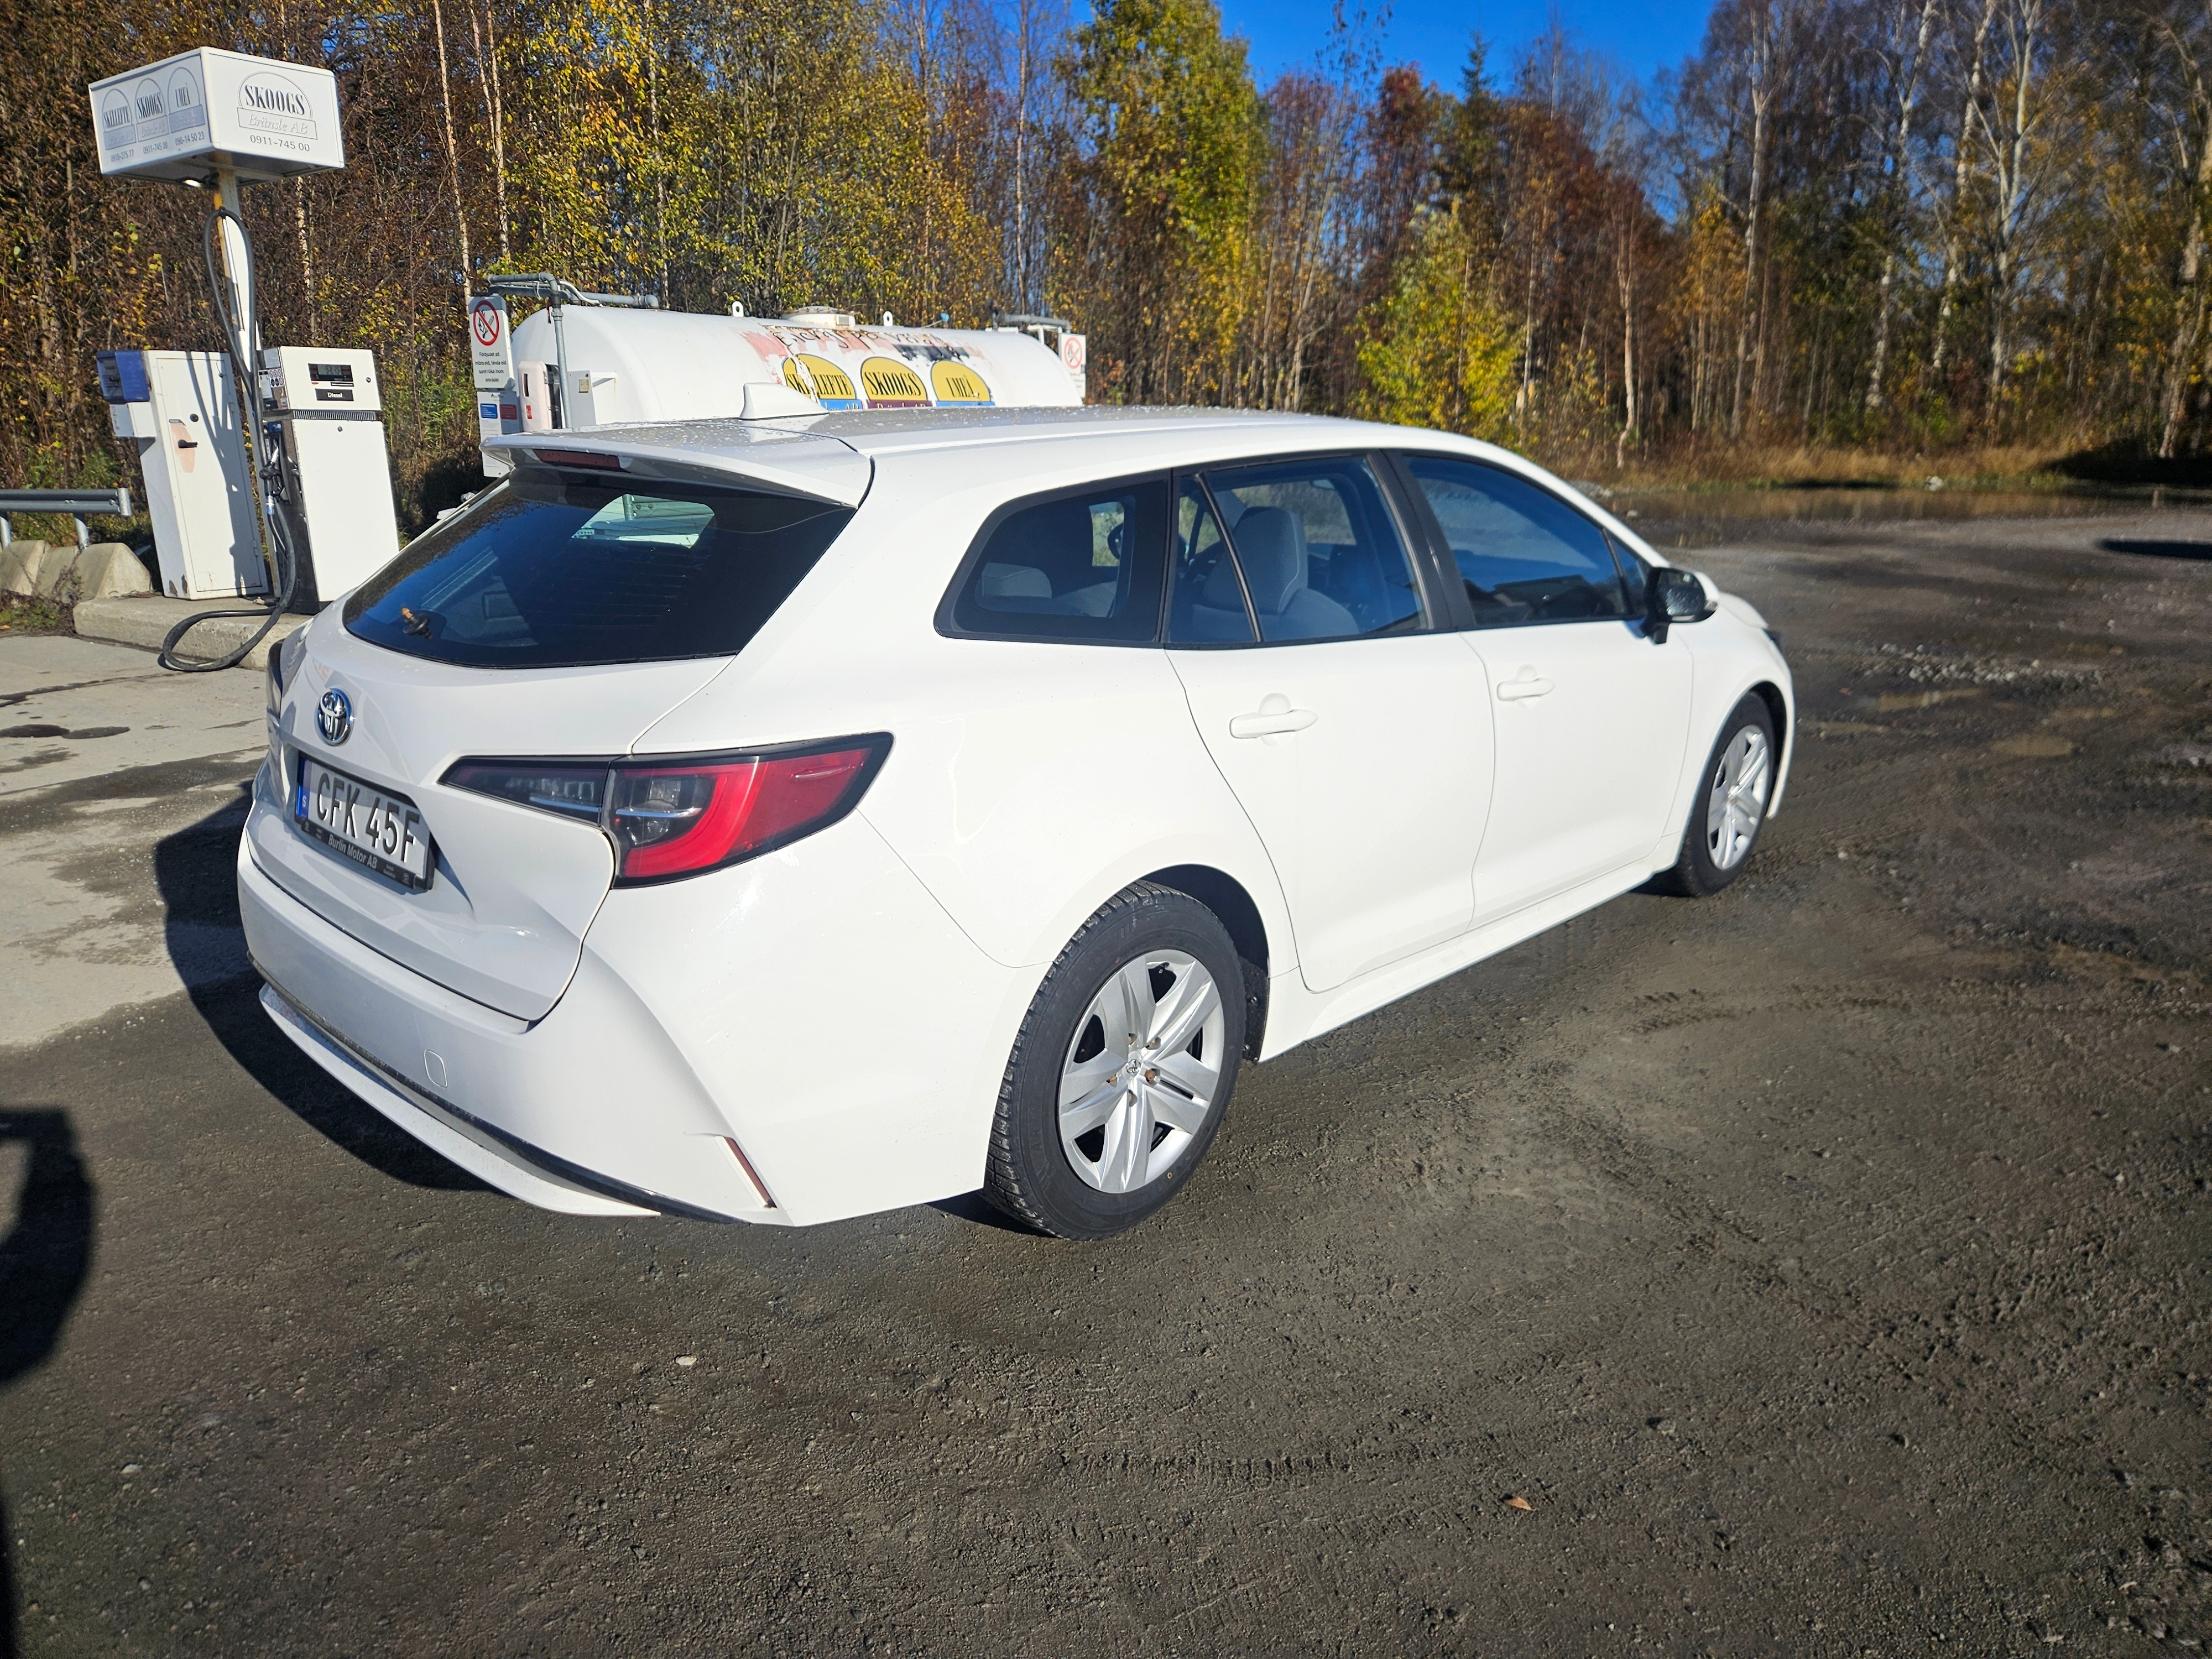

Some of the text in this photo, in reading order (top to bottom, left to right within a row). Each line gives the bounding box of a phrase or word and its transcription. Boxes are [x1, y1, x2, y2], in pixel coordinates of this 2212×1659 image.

[136, 92, 163, 119] SKOOGS
[175, 82, 191, 108] UMEÅ
[245, 85, 305, 115] SKOOGS
[103, 105, 131, 129] SKELLEFTE
[248, 114, 308, 134] Bränsle AB
[143, 140, 168, 154] 0911-745 00
[190, 133, 197, 142] 50
[197, 131, 205, 140] 23
[250, 134, 310, 152] 0911-745 00
[786, 373, 852, 395] SKLEFTE
[864, 372, 921, 396] SKOOGS
[946, 373, 975, 397] UMEÅ
[302, 795, 307, 807] S
[317, 772, 420, 863] CFK 45F
[328, 833, 377, 869] Burlin Motor AB
